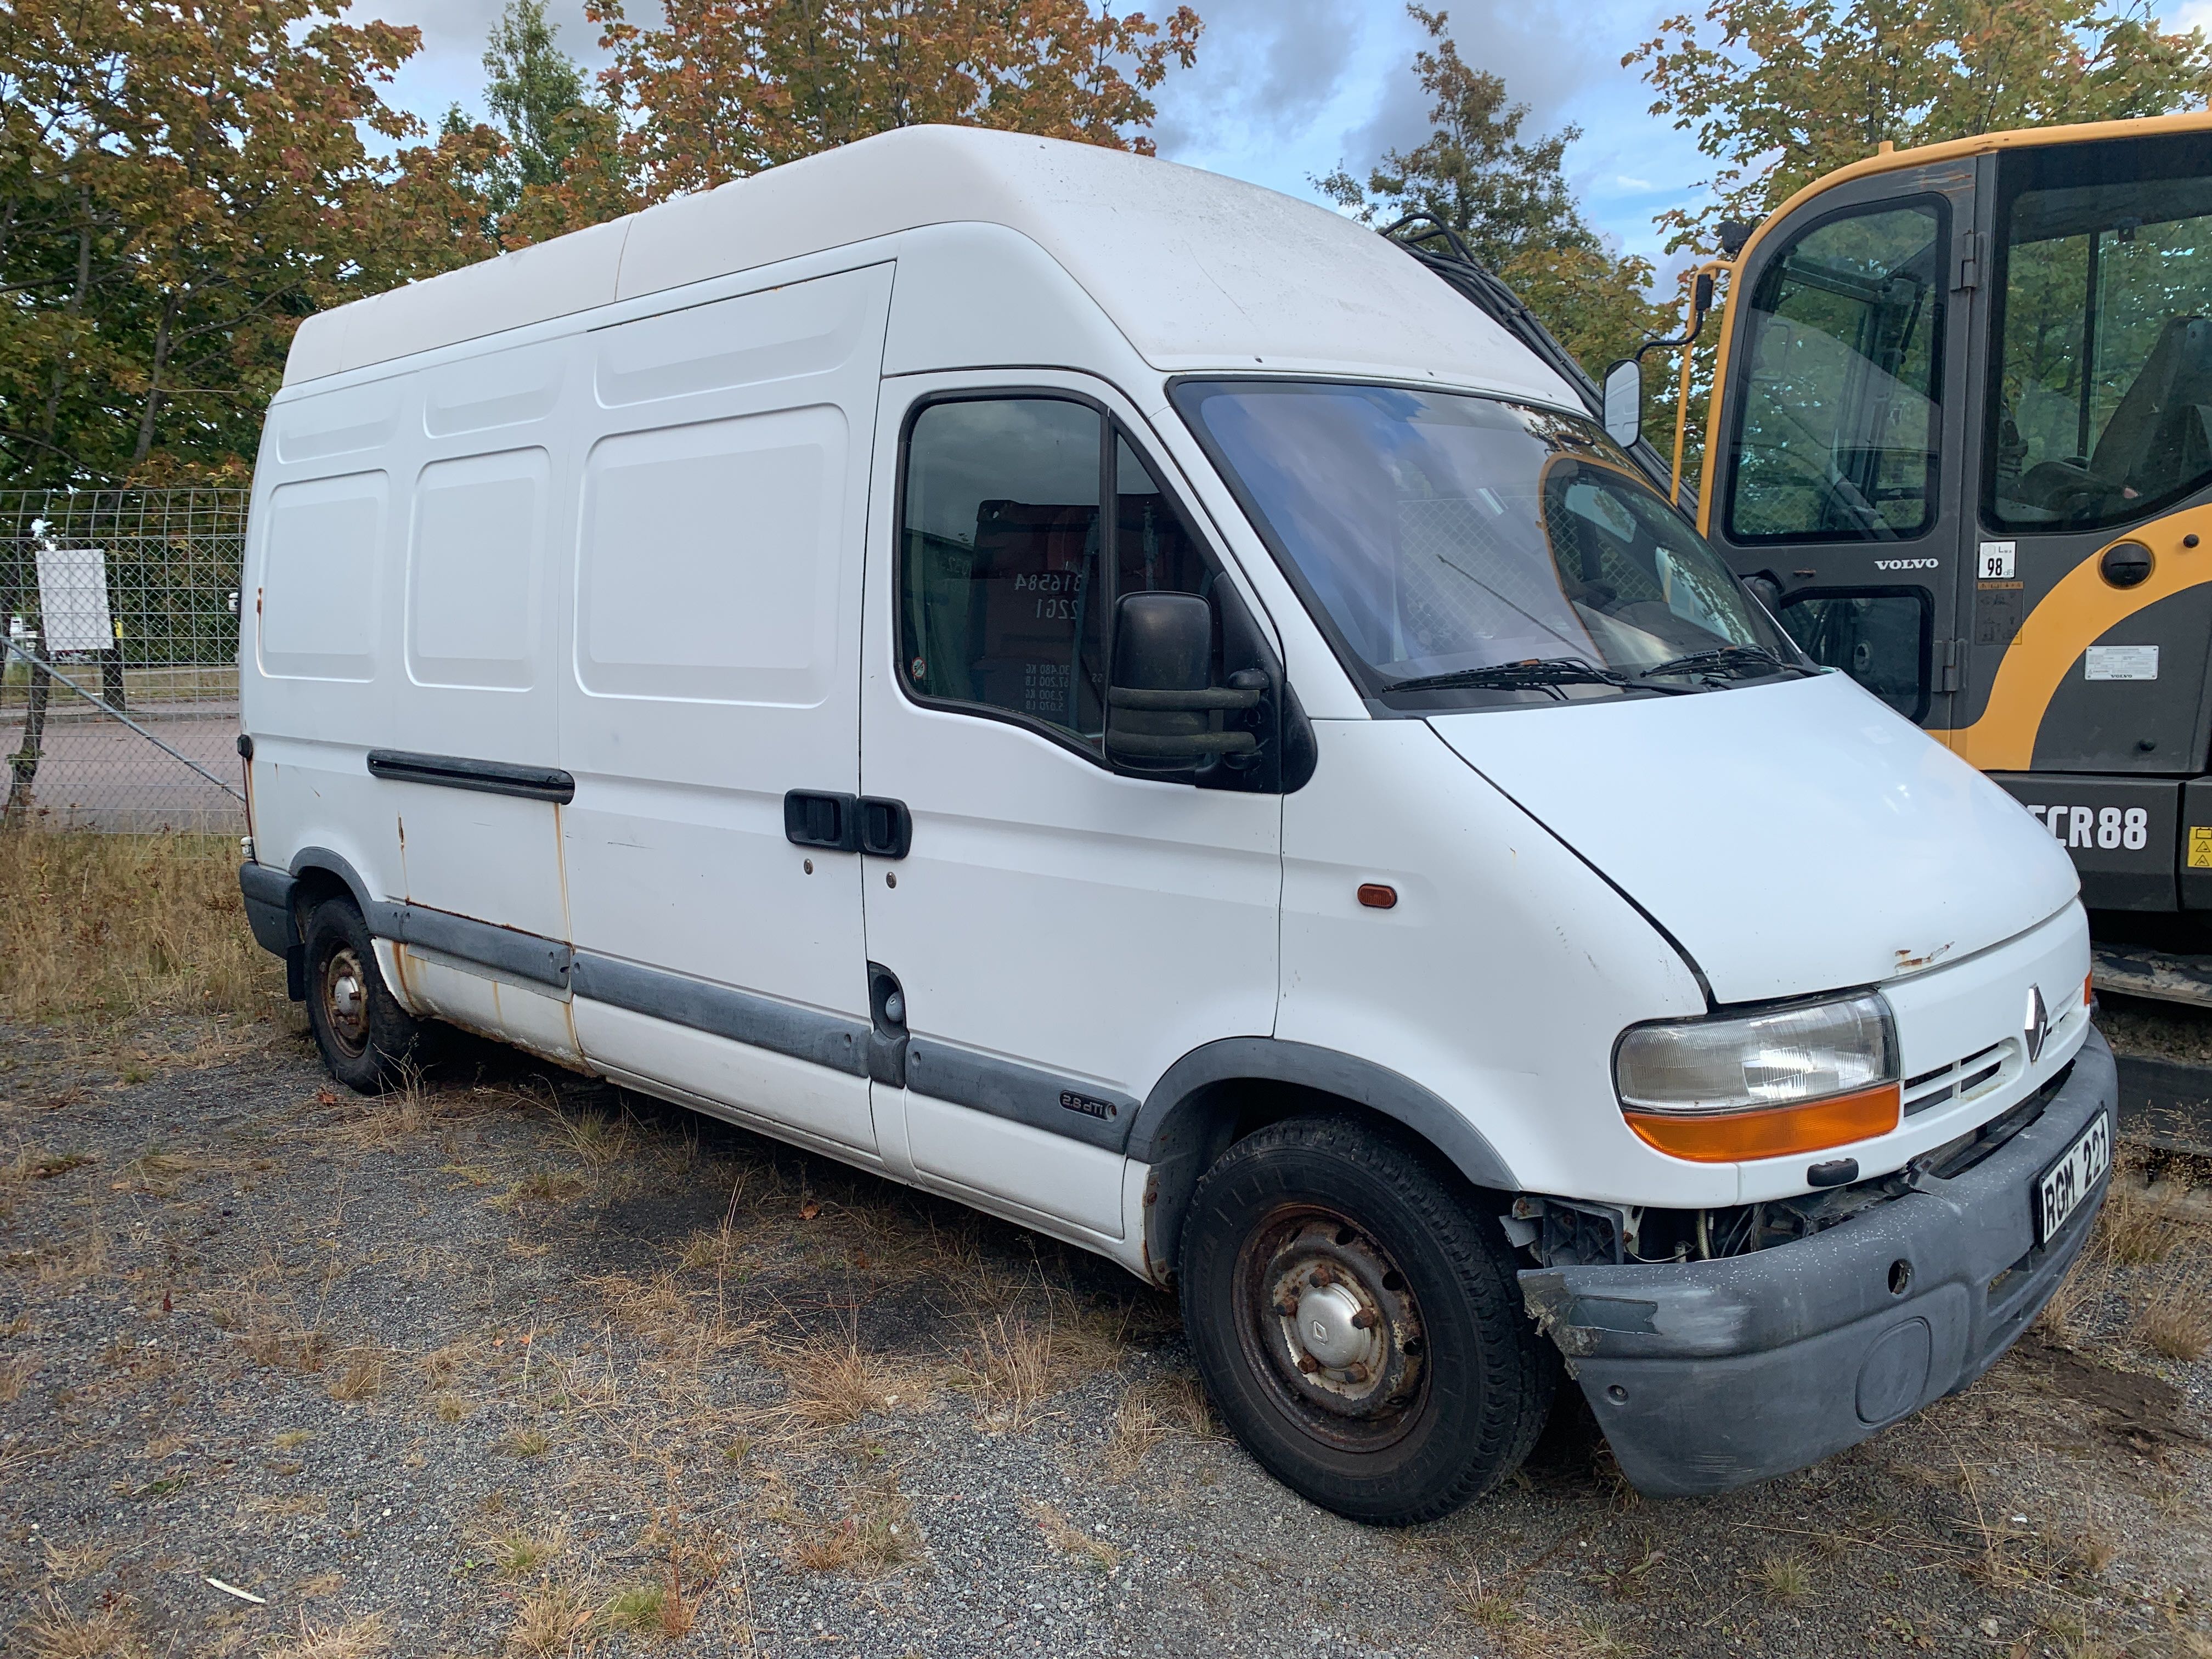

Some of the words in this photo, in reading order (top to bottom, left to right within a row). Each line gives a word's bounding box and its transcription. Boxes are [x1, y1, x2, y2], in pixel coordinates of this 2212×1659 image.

[1874, 558, 1939, 570] VOLVO
[1987, 557, 2002, 577] 98
[1062, 1094, 1081, 1109] 2.8
[2045, 1158, 2075, 1235] RGM
[2084, 1118, 2106, 1190] 221
